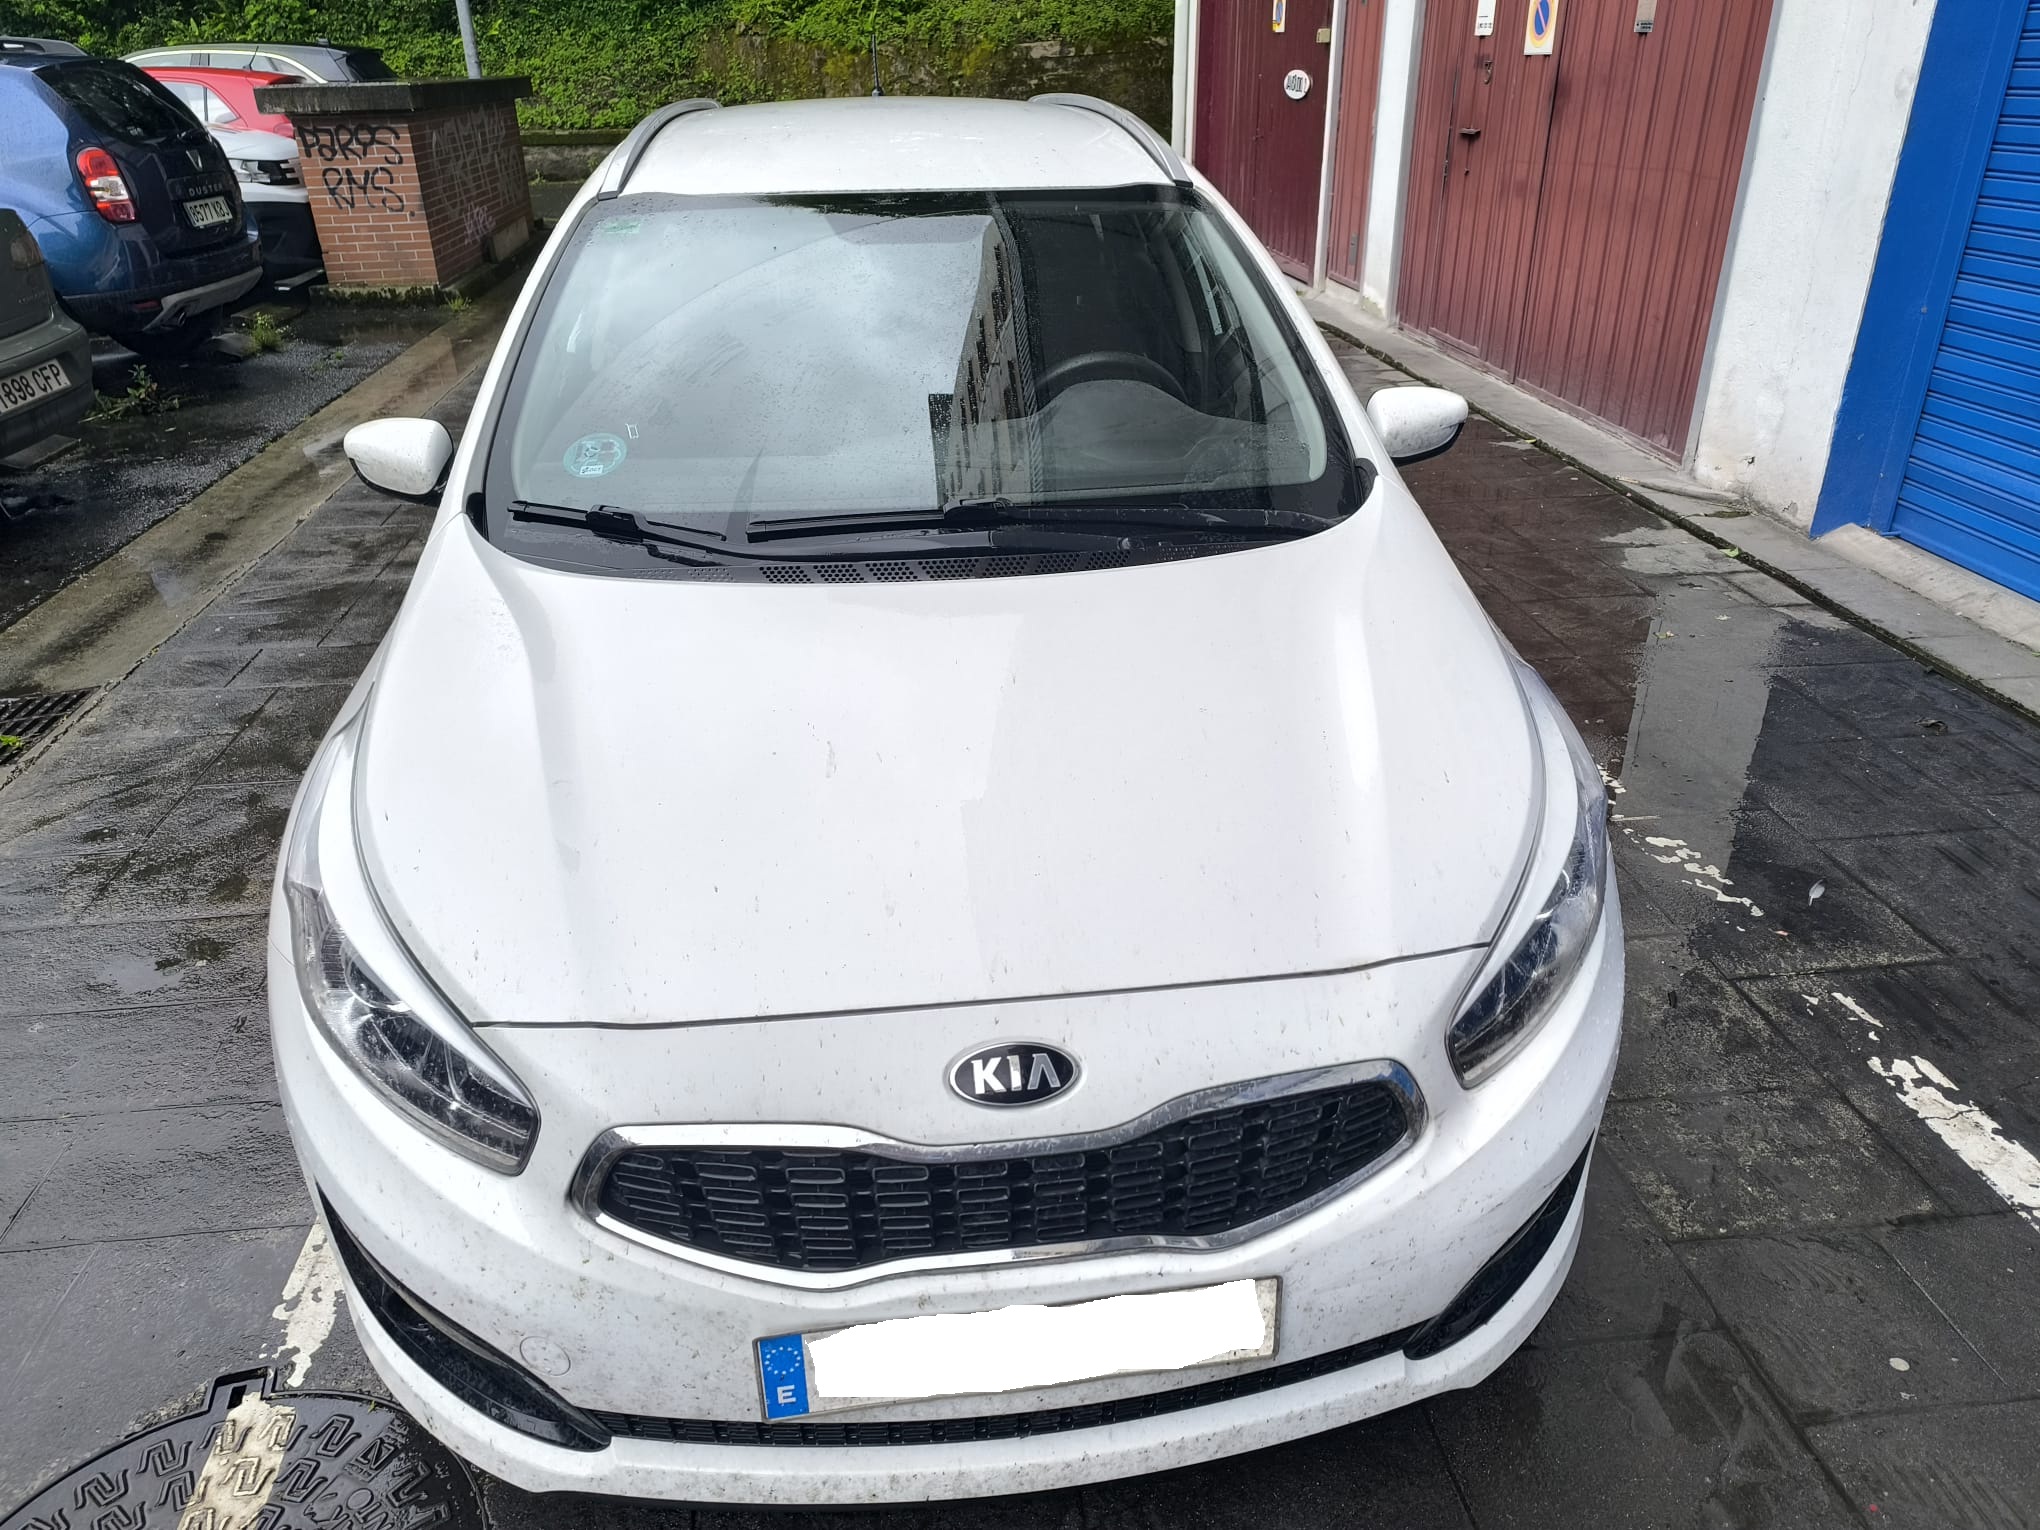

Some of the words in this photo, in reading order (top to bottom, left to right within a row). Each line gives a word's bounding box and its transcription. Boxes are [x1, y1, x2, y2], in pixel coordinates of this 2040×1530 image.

[188, 182, 223, 197] DUSTER
[31, 363, 62, 393] CFP
[970, 1052, 1062, 1095] KIA
[777, 1384, 797, 1405] E
